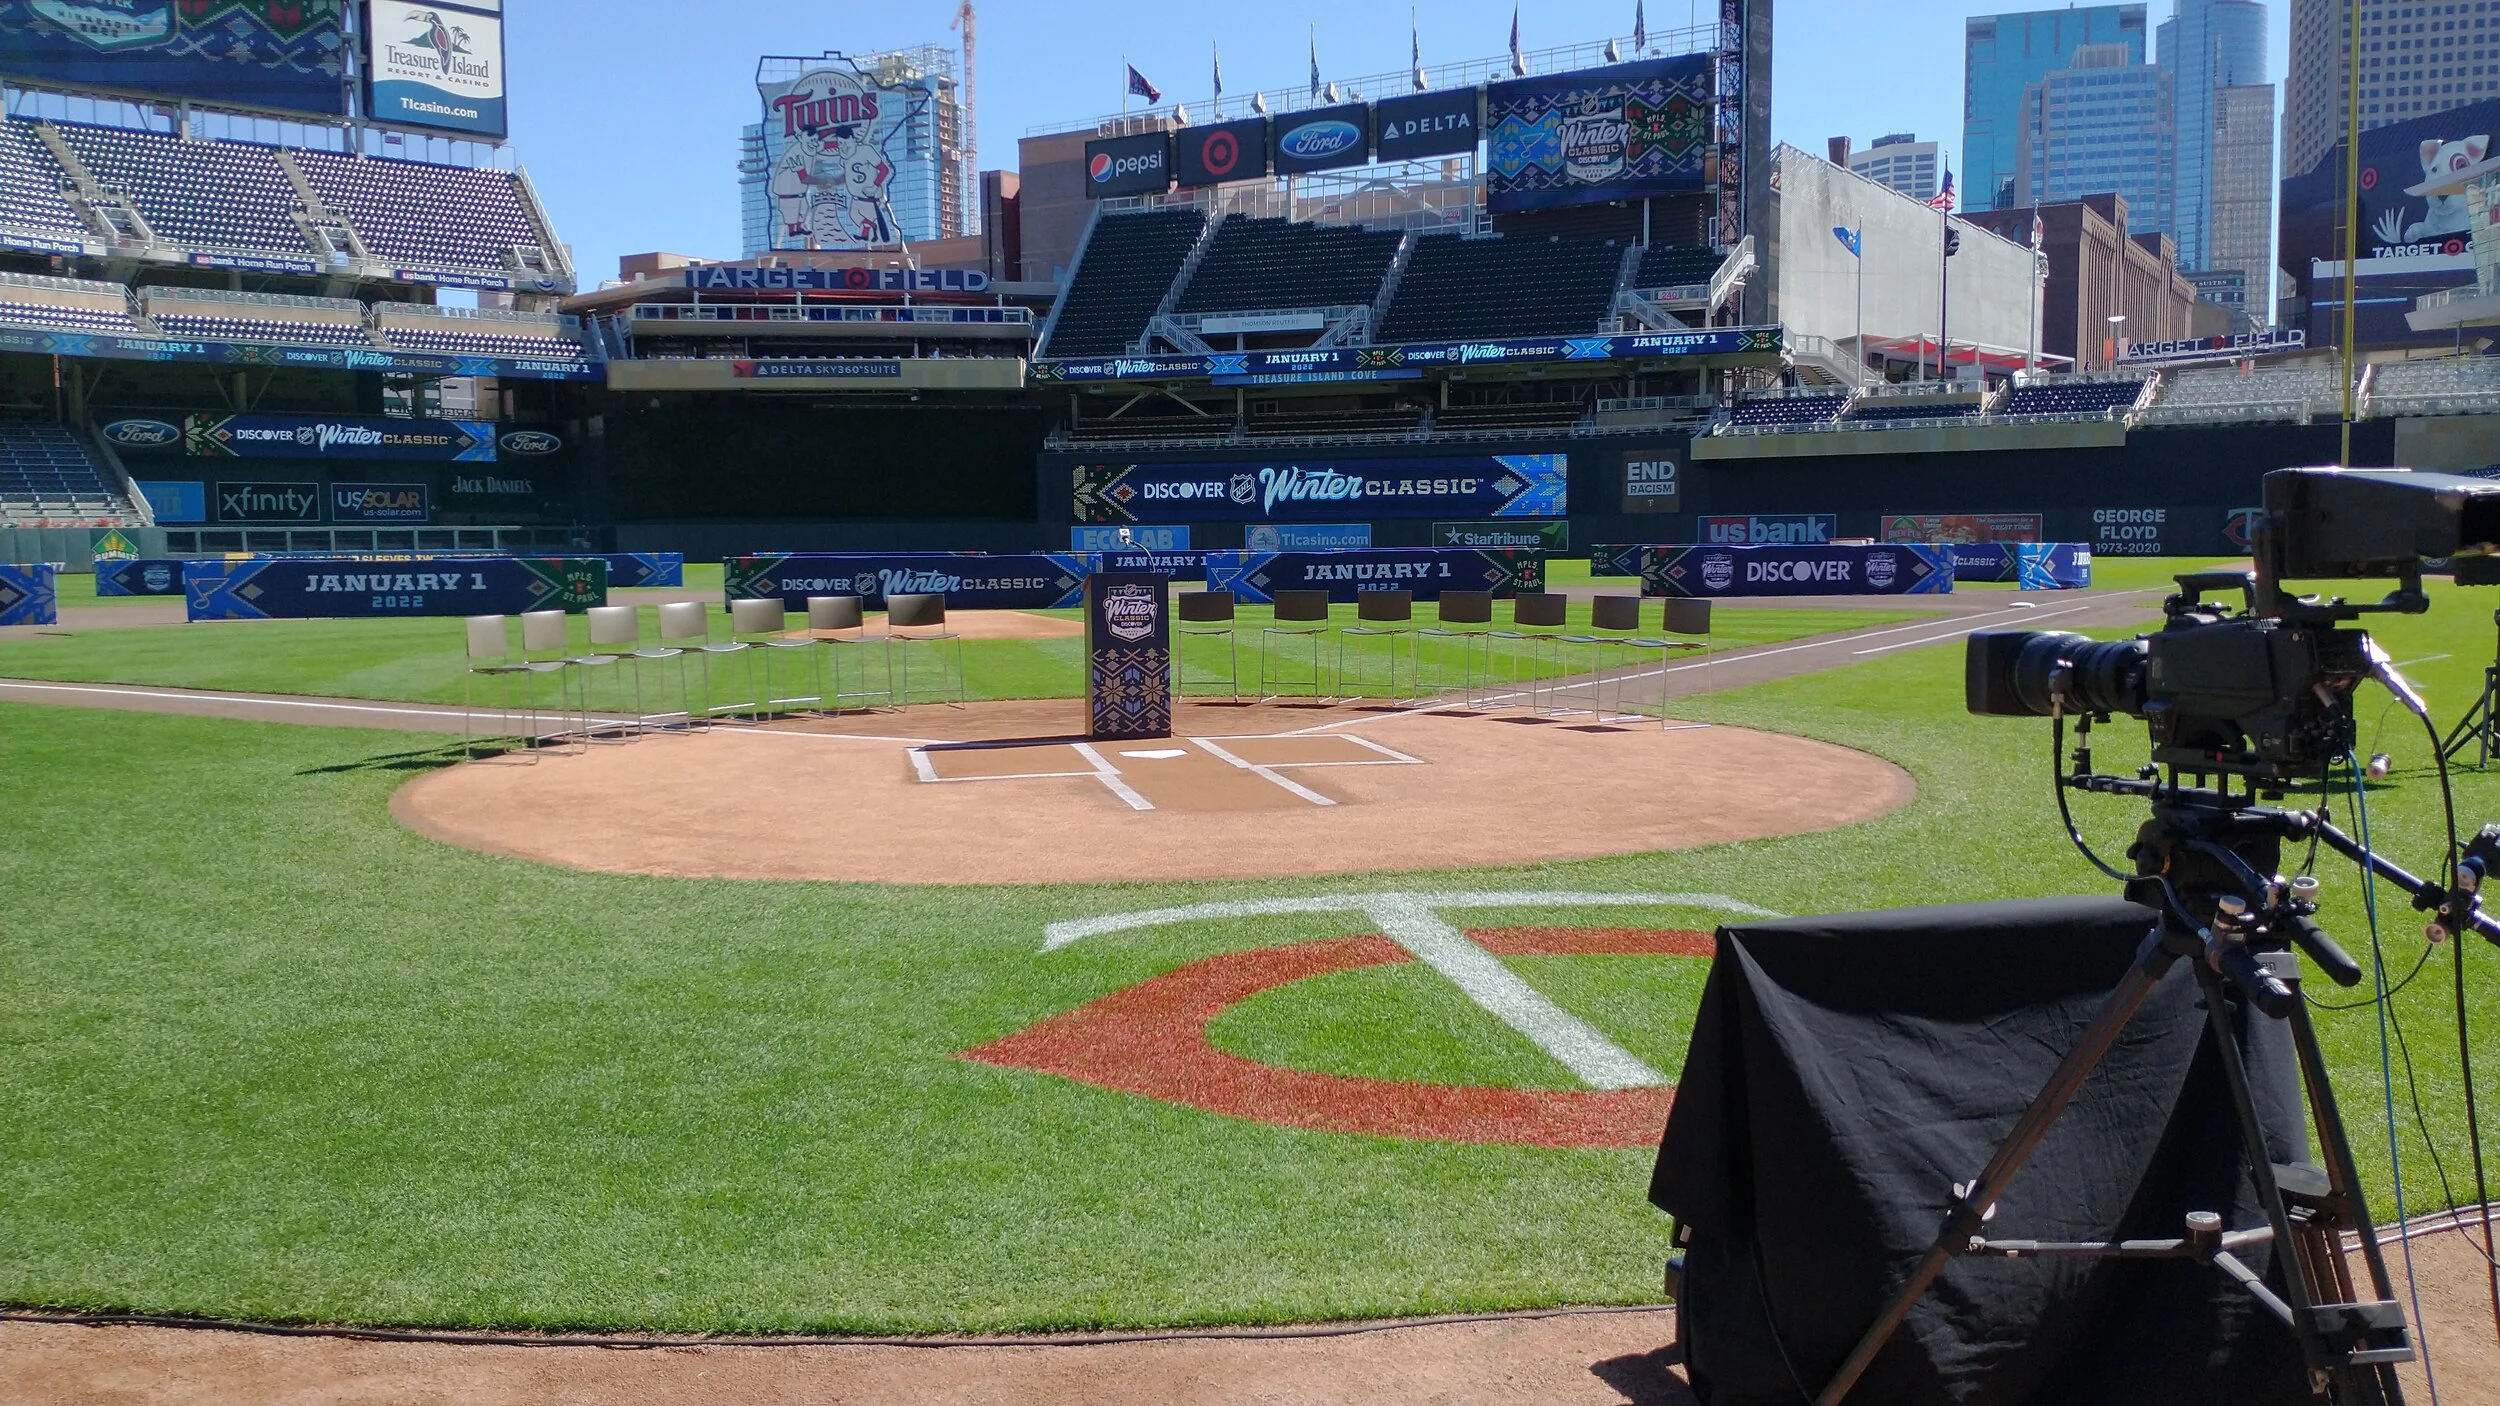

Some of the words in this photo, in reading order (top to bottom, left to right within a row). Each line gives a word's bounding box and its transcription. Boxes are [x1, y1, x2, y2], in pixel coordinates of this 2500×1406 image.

[385, 44, 439, 70] Treasure
[452, 56, 490, 79] Island
[388, 67, 430, 79] RESORT
[448, 76, 490, 88] CASINO
[400, 96, 478, 118] TIcasino.com
[772, 87, 879, 138] Twins
[1405, 111, 1470, 136] DELTA
[1296, 127, 1343, 152] Ford
[1556, 119, 1630, 158] Winter
[1568, 144, 1620, 157] CLASSIC
[1115, 149, 1162, 178] pepsi
[1578, 155, 1609, 164] DISCOVER
[3, 236, 31, 248] Home
[33, 239, 51, 250] Run
[52, 241, 80, 253] Porch
[2372, 242, 2443, 259] TARGET
[237, 258, 264, 268] Home
[265, 260, 284, 269] Run
[285, 261, 311, 271] Porch
[438, 274, 463, 284] Home
[463, 276, 480, 285] Run
[481, 278, 504, 287] Porch
[686, 267, 840, 289] TARGET
[879, 269, 989, 291] FIELD
[116, 338, 190, 353] JANUARY
[195, 343, 206, 354] 1
[1632, 334, 1706, 348] JANUARY
[1709, 334, 1718, 344] 1
[2128, 337, 2204, 357] ARGET
[2234, 329, 2305, 348] FIELD
[1265, 353, 1328, 365] JANUARY
[1332, 352, 1340, 362] 1
[1408, 350, 1446, 361] DISCOVER
[1460, 344, 1507, 364] Winter
[1506, 346, 1556, 357] CLASSIC
[1662, 346, 1688, 355] 2022
[287, 351, 329, 362] DISCOVER
[344, 349, 394, 370] Winter
[393, 359, 443, 369] CLASSIC
[515, 360, 582, 374] JANUARY
[583, 364, 591, 374] 1
[771, 365, 812, 374] DELTA
[864, 365, 897, 374] SUITE
[1069, 365, 1102, 375] DISCOVER
[1115, 359, 1155, 379] Winter
[1155, 362, 1198, 372] CLASSIC
[1252, 373, 1302, 384] TREASURE
[1308, 371, 1345, 382] ISLAND
[1351, 370, 1377, 380] COVE
[117, 423, 165, 444] Ford
[236, 429, 294, 441] DISCOVER
[315, 423, 383, 451] Winter
[383, 434, 449, 445] CLASSIC
[511, 433, 550, 451] Ford
[1627, 461, 1676, 481] END
[452, 476, 483, 494] JACK
[486, 476, 533, 494] DANIEL'S
[1144, 481, 1225, 499] DISCOVER
[1259, 465, 1362, 516] Winter
[1365, 478, 1478, 496] CLASSIC
[1629, 483, 1674, 494] RACISM
[223, 486, 315, 518] xfinity
[363, 507, 422, 517] us-solar.com
[2093, 509, 2166, 523] GEORGE
[1281, 533, 1369, 546] TIcasino.com
[2100, 525, 2157, 540] FLOYD
[94, 550, 139, 561] SUMMIT
[2095, 542, 2161, 554] 1973-2020
[1115, 556, 1196, 568] JANUARY
[1517, 560, 1538, 570] MPLS.
[1865, 561, 1897, 574] Winter
[1957, 557, 1996, 567] CLASSIC
[567, 571, 594, 583] MPLS.
[1304, 562, 1435, 580] JANUARY
[1439, 562, 1451, 578] 1
[1747, 560, 1851, 582] DISCOVER
[305, 573, 462, 592] JANUARY
[471, 573, 487, 590] 1
[782, 577, 852, 592] DISCOVER
[878, 567, 960, 603] Winter
[962, 577, 1045, 590] CLASSIC
[1357, 582, 1399, 592] 2022
[1513, 578, 1523, 588] ST.
[1524, 578, 1543, 589] PAUL
[372, 595, 424, 608] 2022
[576, 591, 601, 603] PAUL
[1105, 599, 1156, 621] Winter
